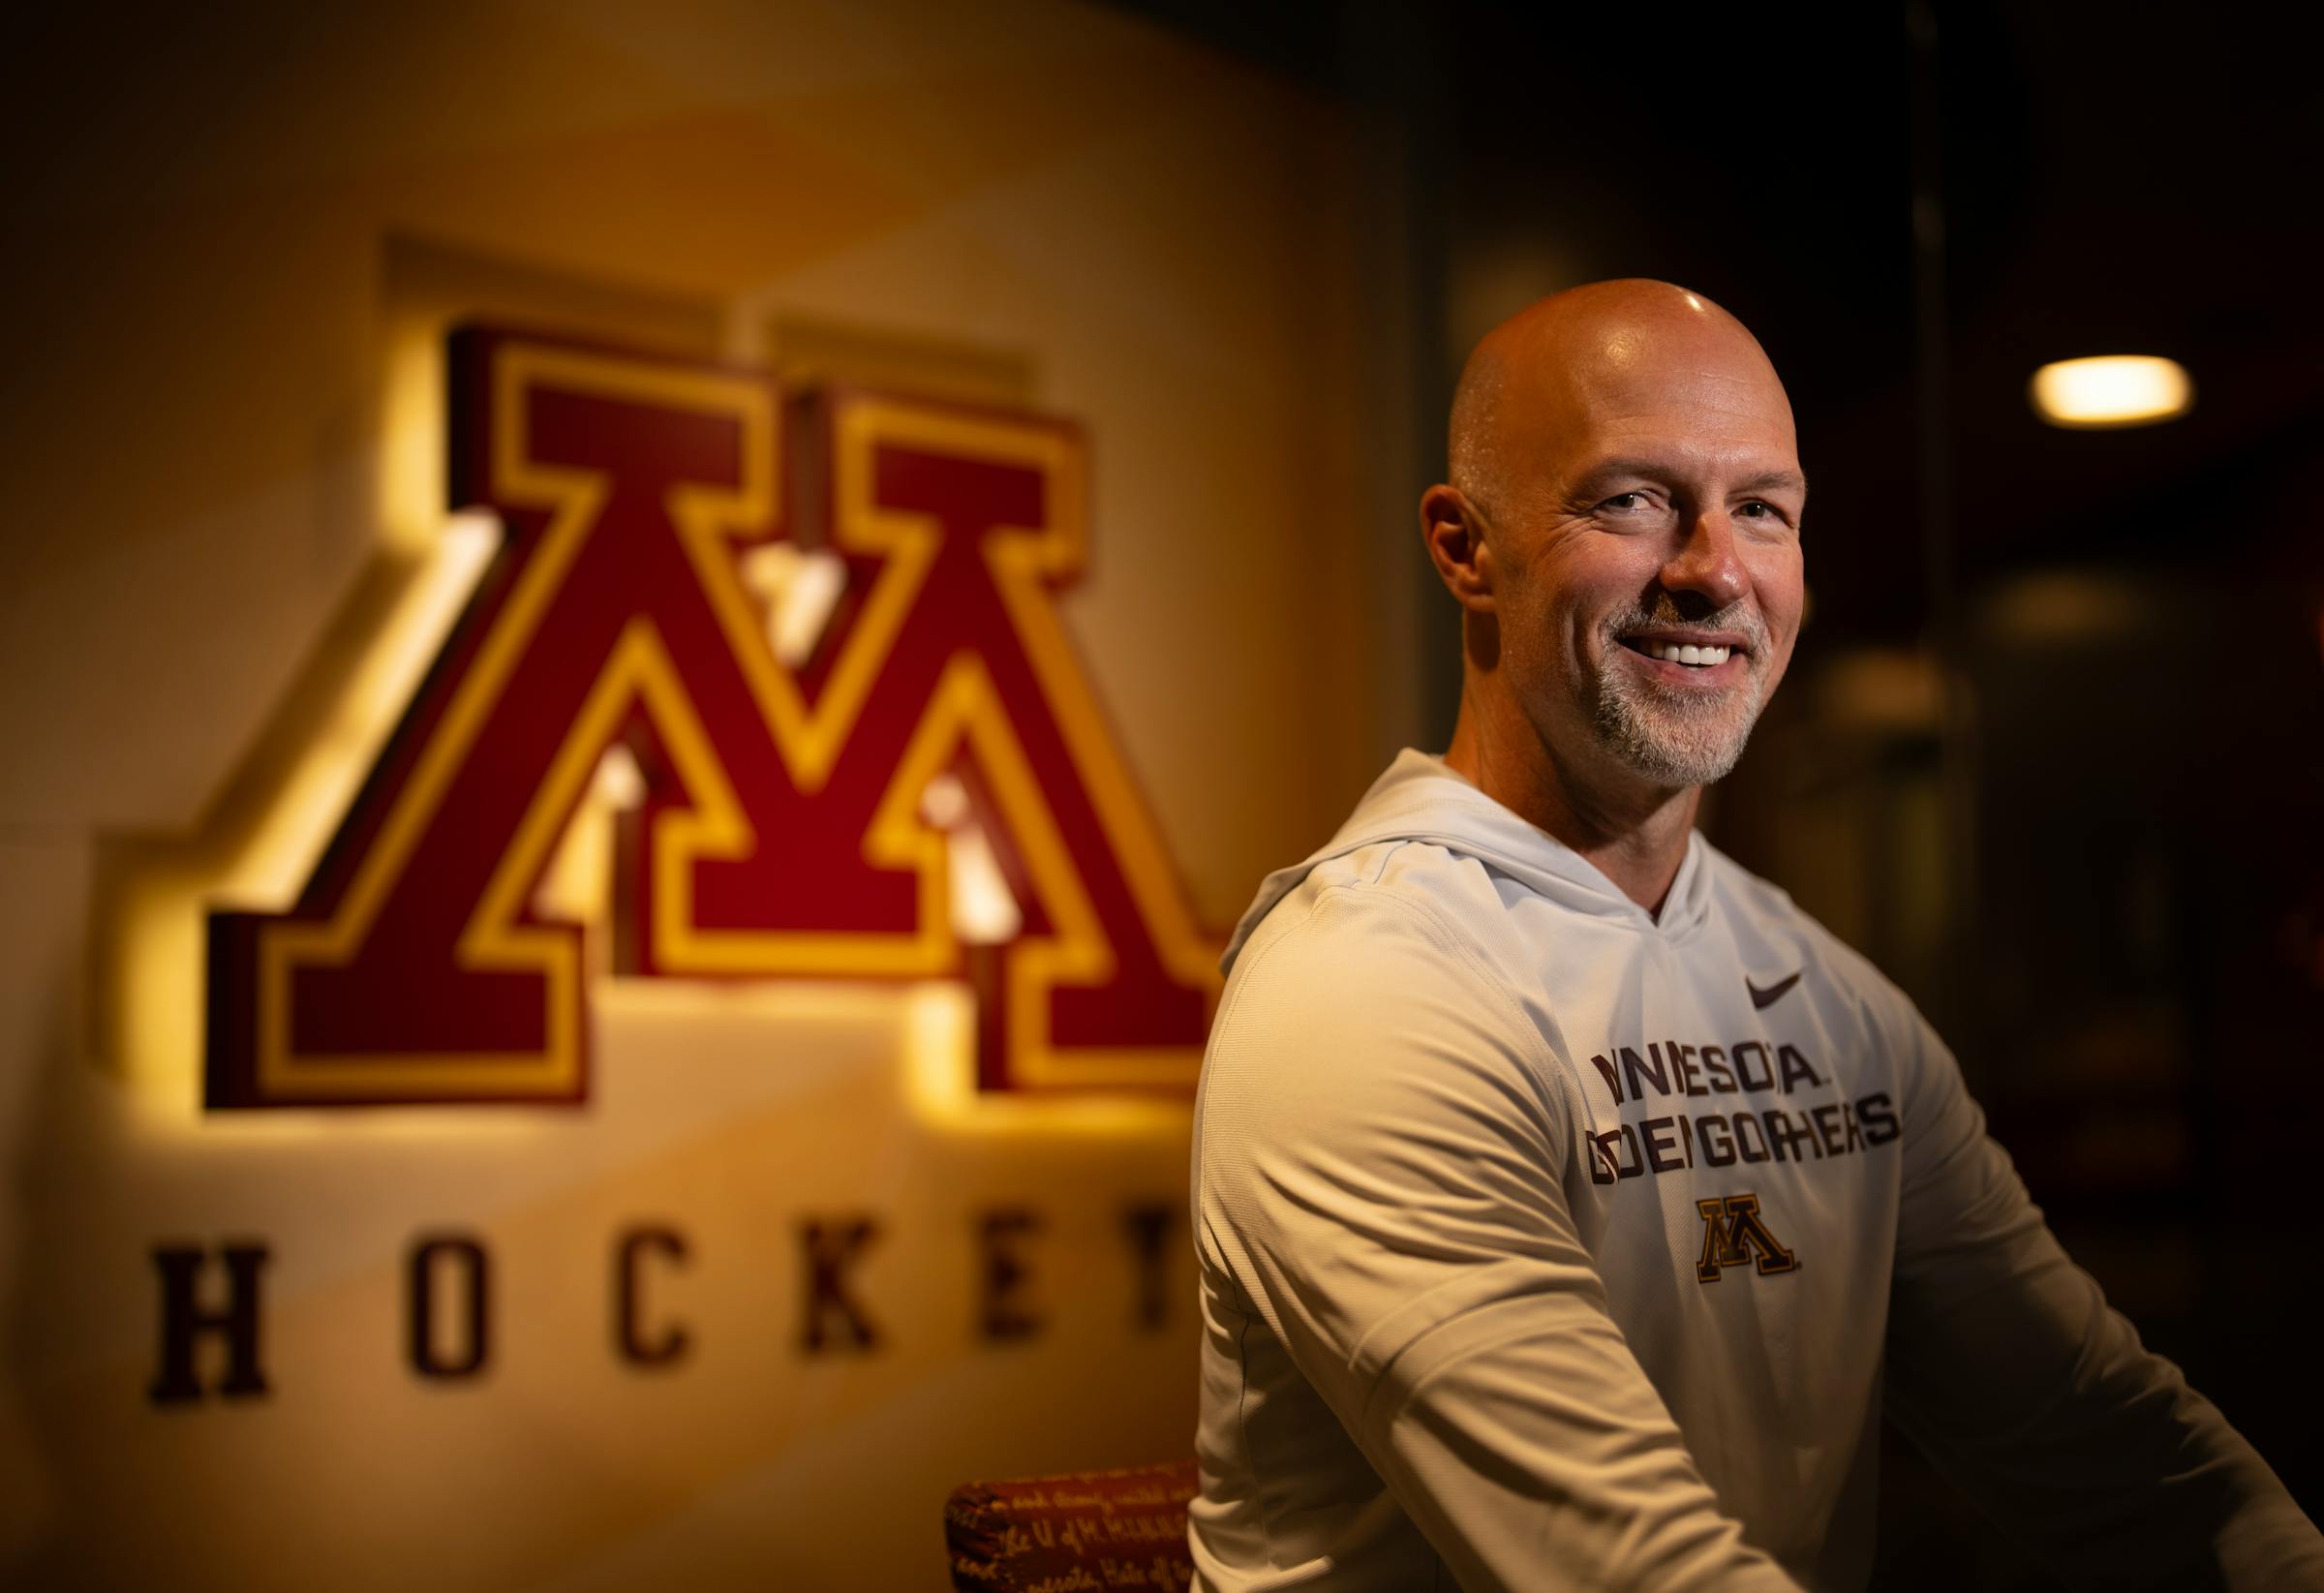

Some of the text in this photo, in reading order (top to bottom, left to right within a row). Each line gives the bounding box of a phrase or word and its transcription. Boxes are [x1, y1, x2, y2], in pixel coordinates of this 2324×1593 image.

[203, 322, 1220, 1110] M
[1590, 1040, 1821, 1106] NNESOA
[148, 1204, 1184, 1405] HOCKEY
[1696, 1193, 1795, 1284] M
